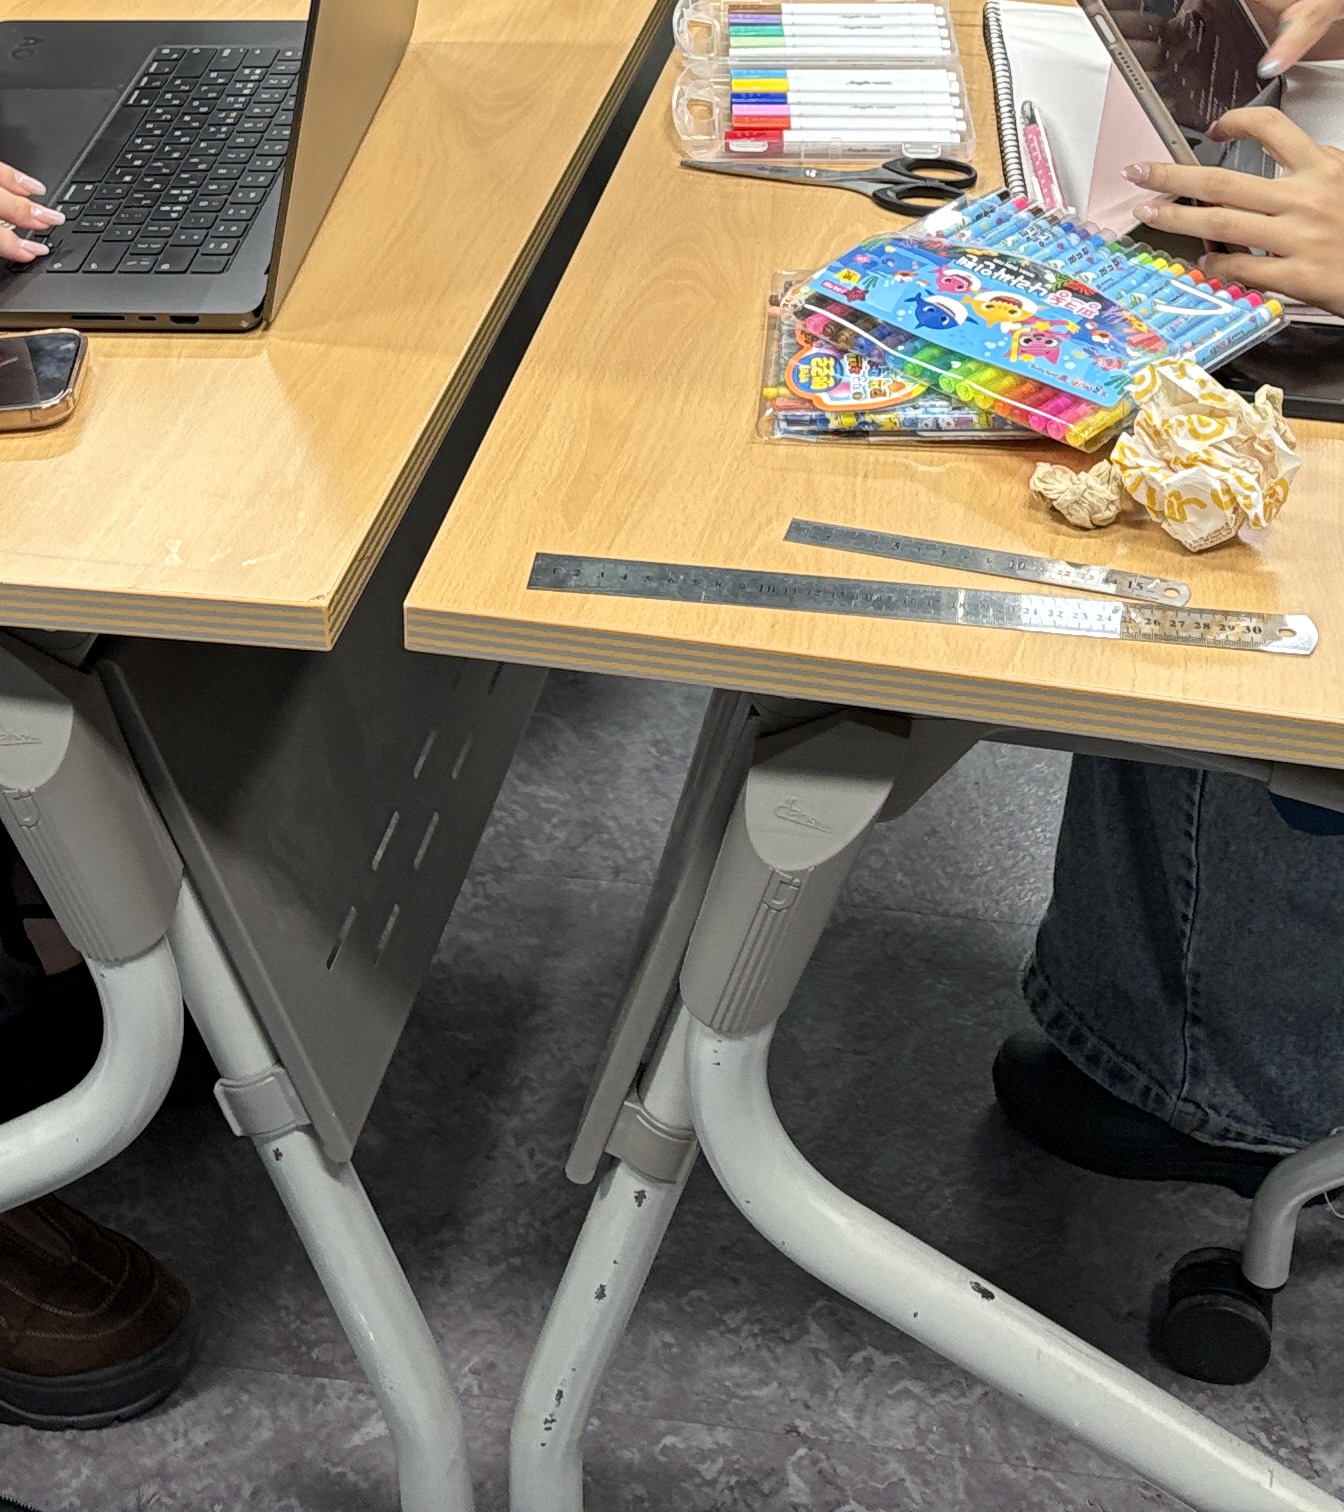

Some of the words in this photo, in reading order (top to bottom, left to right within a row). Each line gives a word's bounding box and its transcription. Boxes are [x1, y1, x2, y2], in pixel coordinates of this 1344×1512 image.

[958, 254, 1046, 296] 나라싸인펜
[1046, 288, 1102, 320] 핑크퐁
[1127, 580, 1143, 590] 15
[1048, 609, 1064, 619] 22
[1145, 618, 1161, 626] 26
[1169, 620, 1185, 628] 27
[1219, 623, 1236, 632] 29
[1242, 626, 1262, 635] 30
